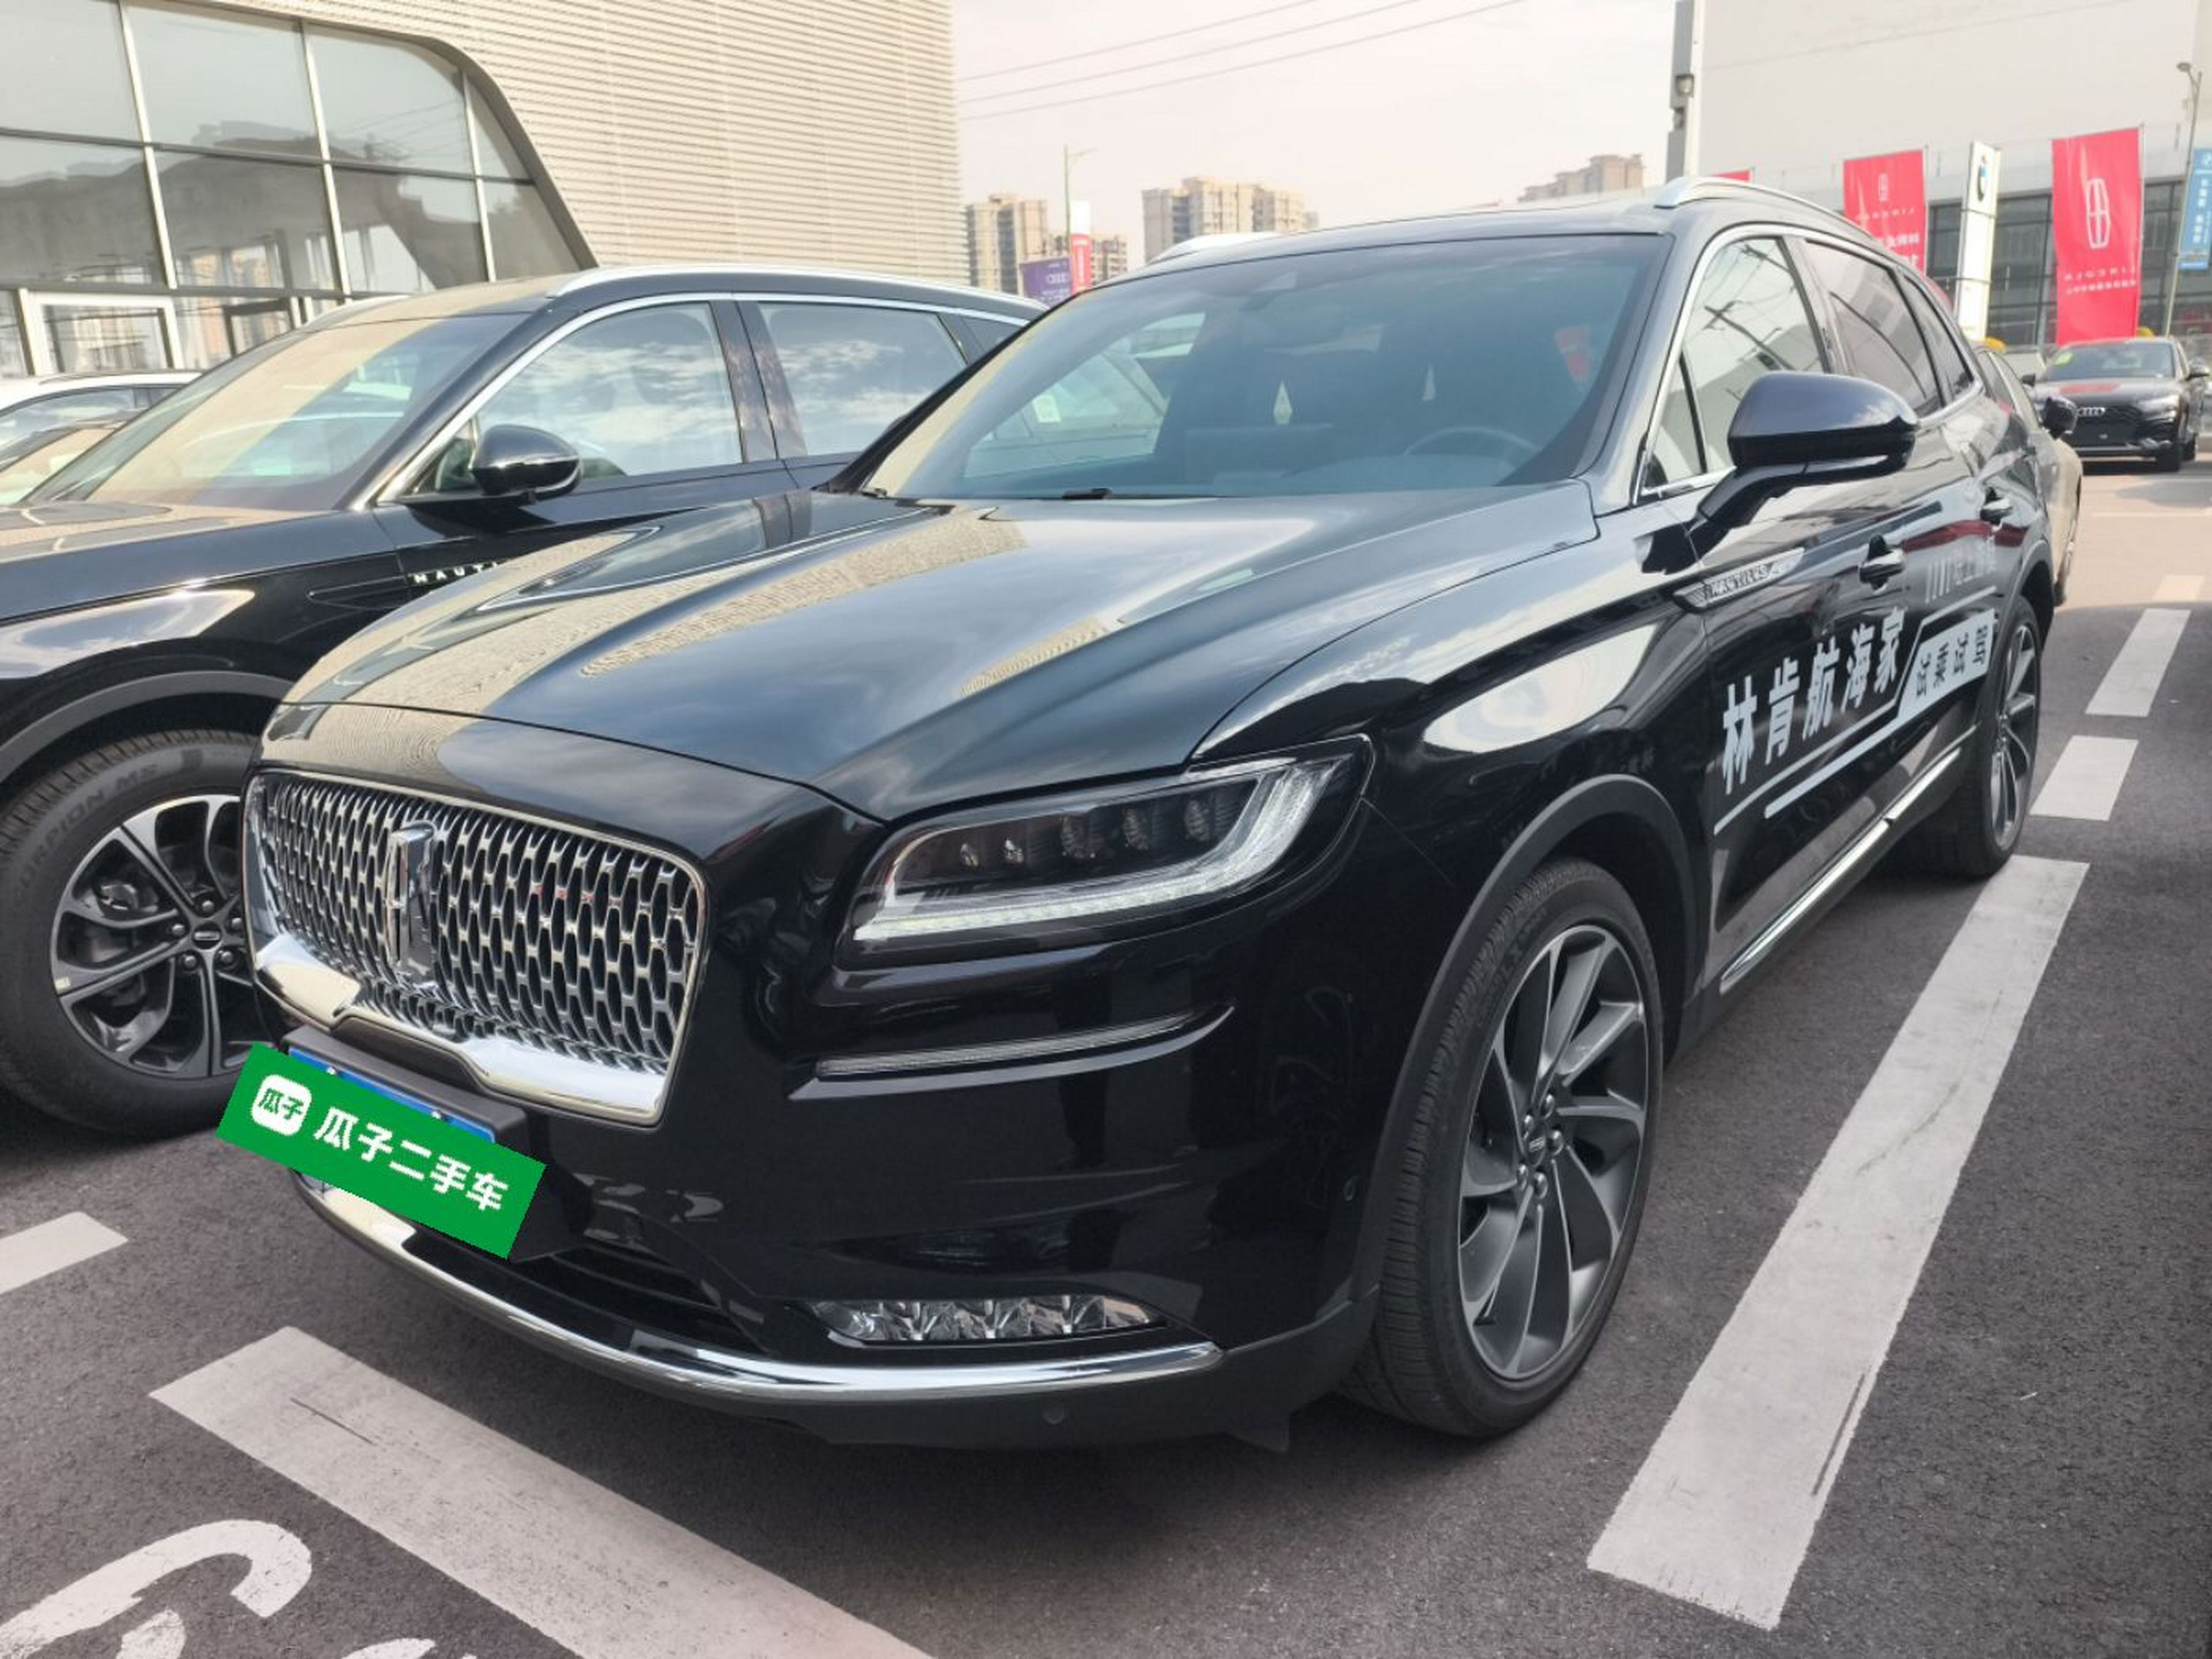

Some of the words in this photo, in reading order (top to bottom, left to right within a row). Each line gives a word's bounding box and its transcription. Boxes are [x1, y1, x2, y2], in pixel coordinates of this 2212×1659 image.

[1722, 607, 1906, 795] 林肯航海家
